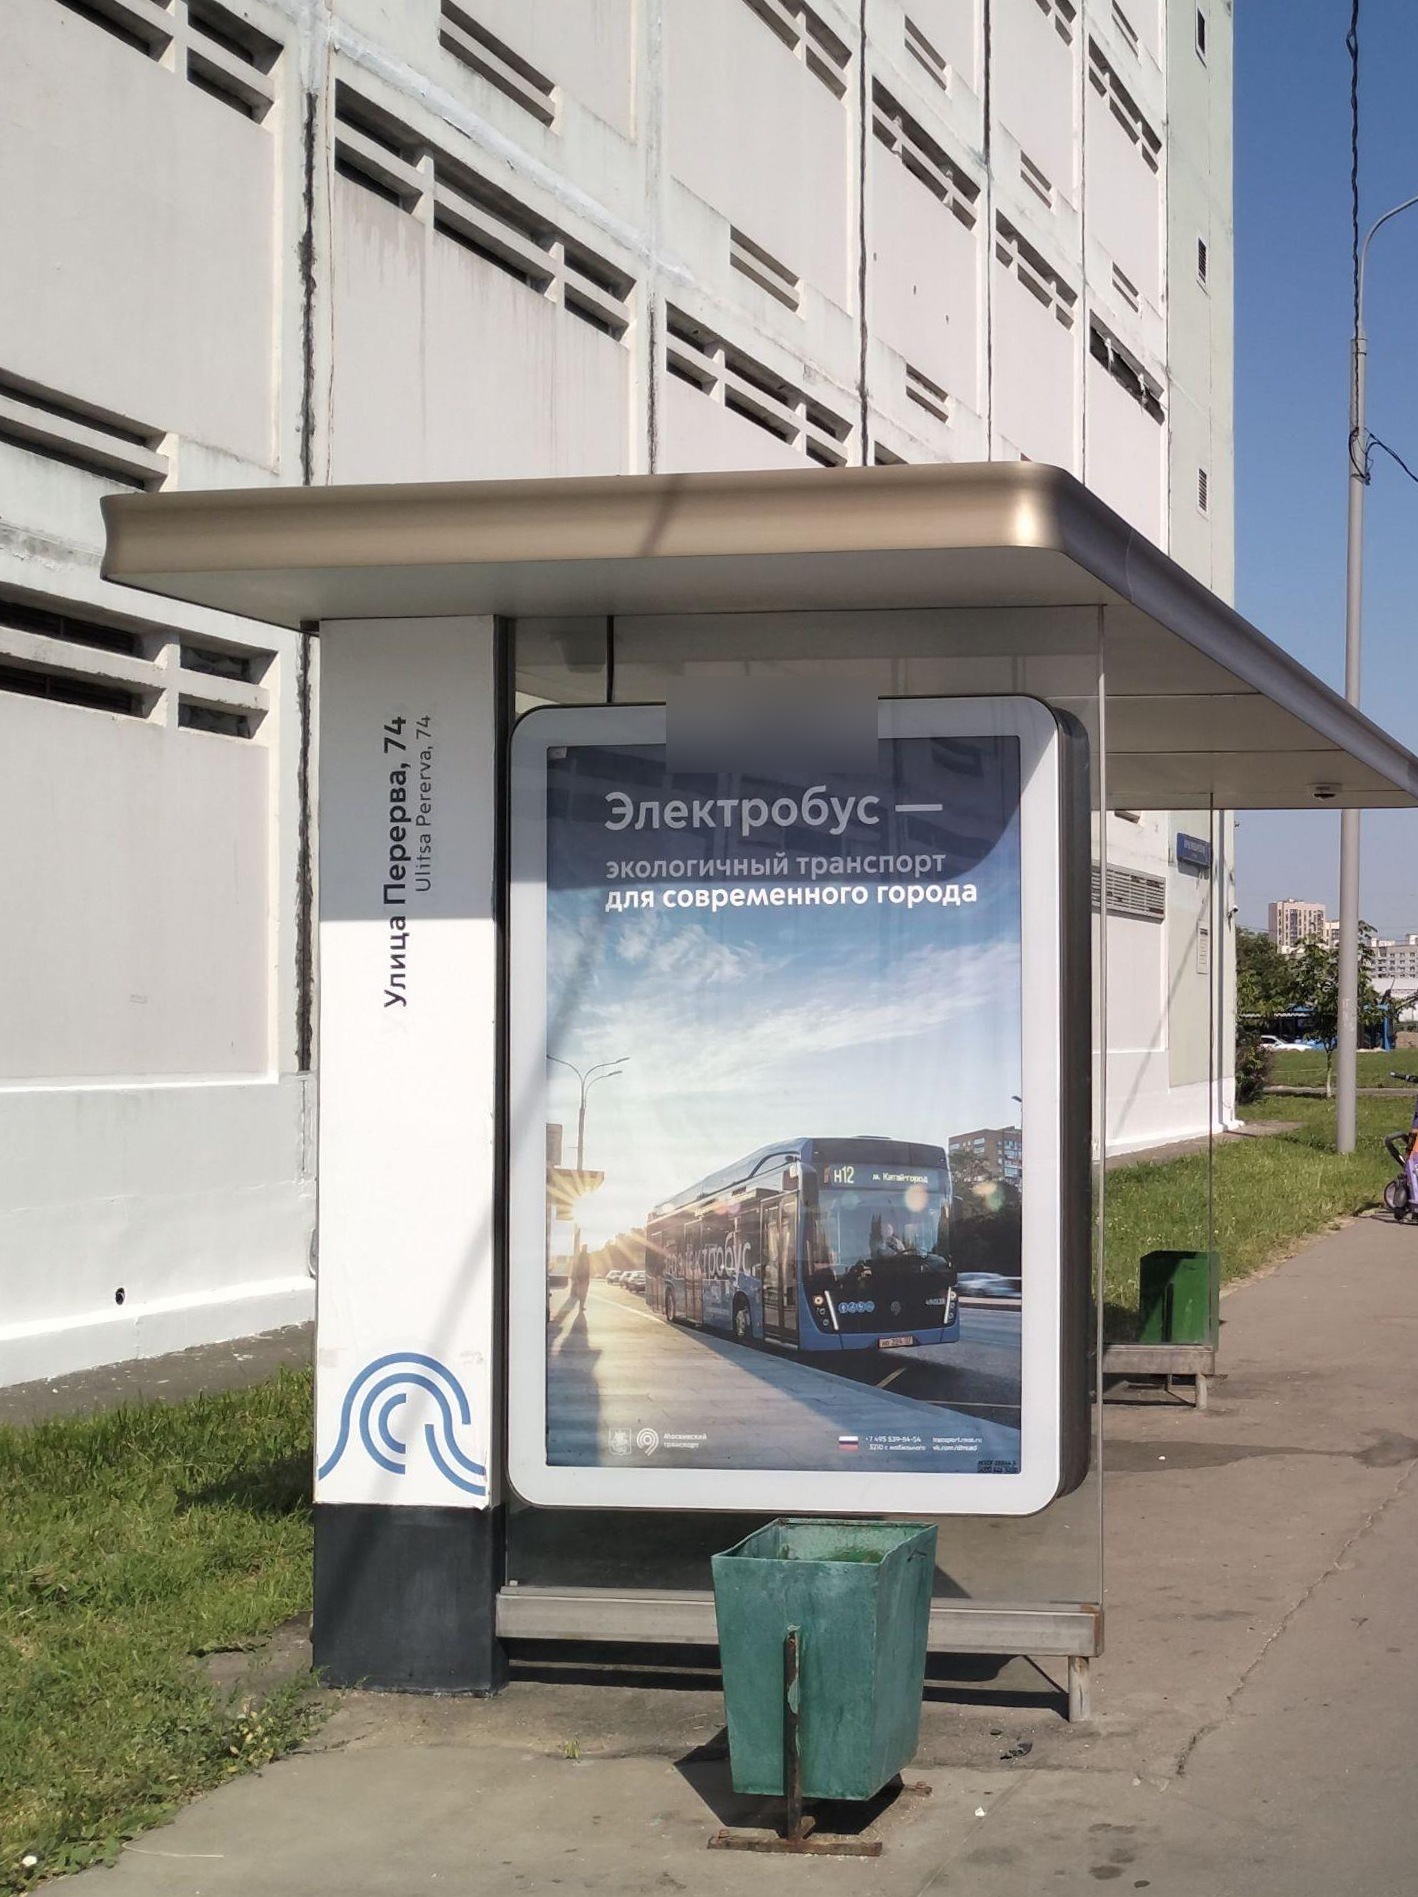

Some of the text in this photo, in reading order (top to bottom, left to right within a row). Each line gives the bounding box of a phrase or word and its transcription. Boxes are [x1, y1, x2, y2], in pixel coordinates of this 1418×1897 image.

[415, 715, 433, 891] Ulitsa Pererva, 74
[604, 784, 880, 836] Электробус
[383, 716, 411, 1008] Улица Перерва, 74
[606, 852, 946, 880] экологичный транспорт
[605, 883, 978, 912] для современного города
